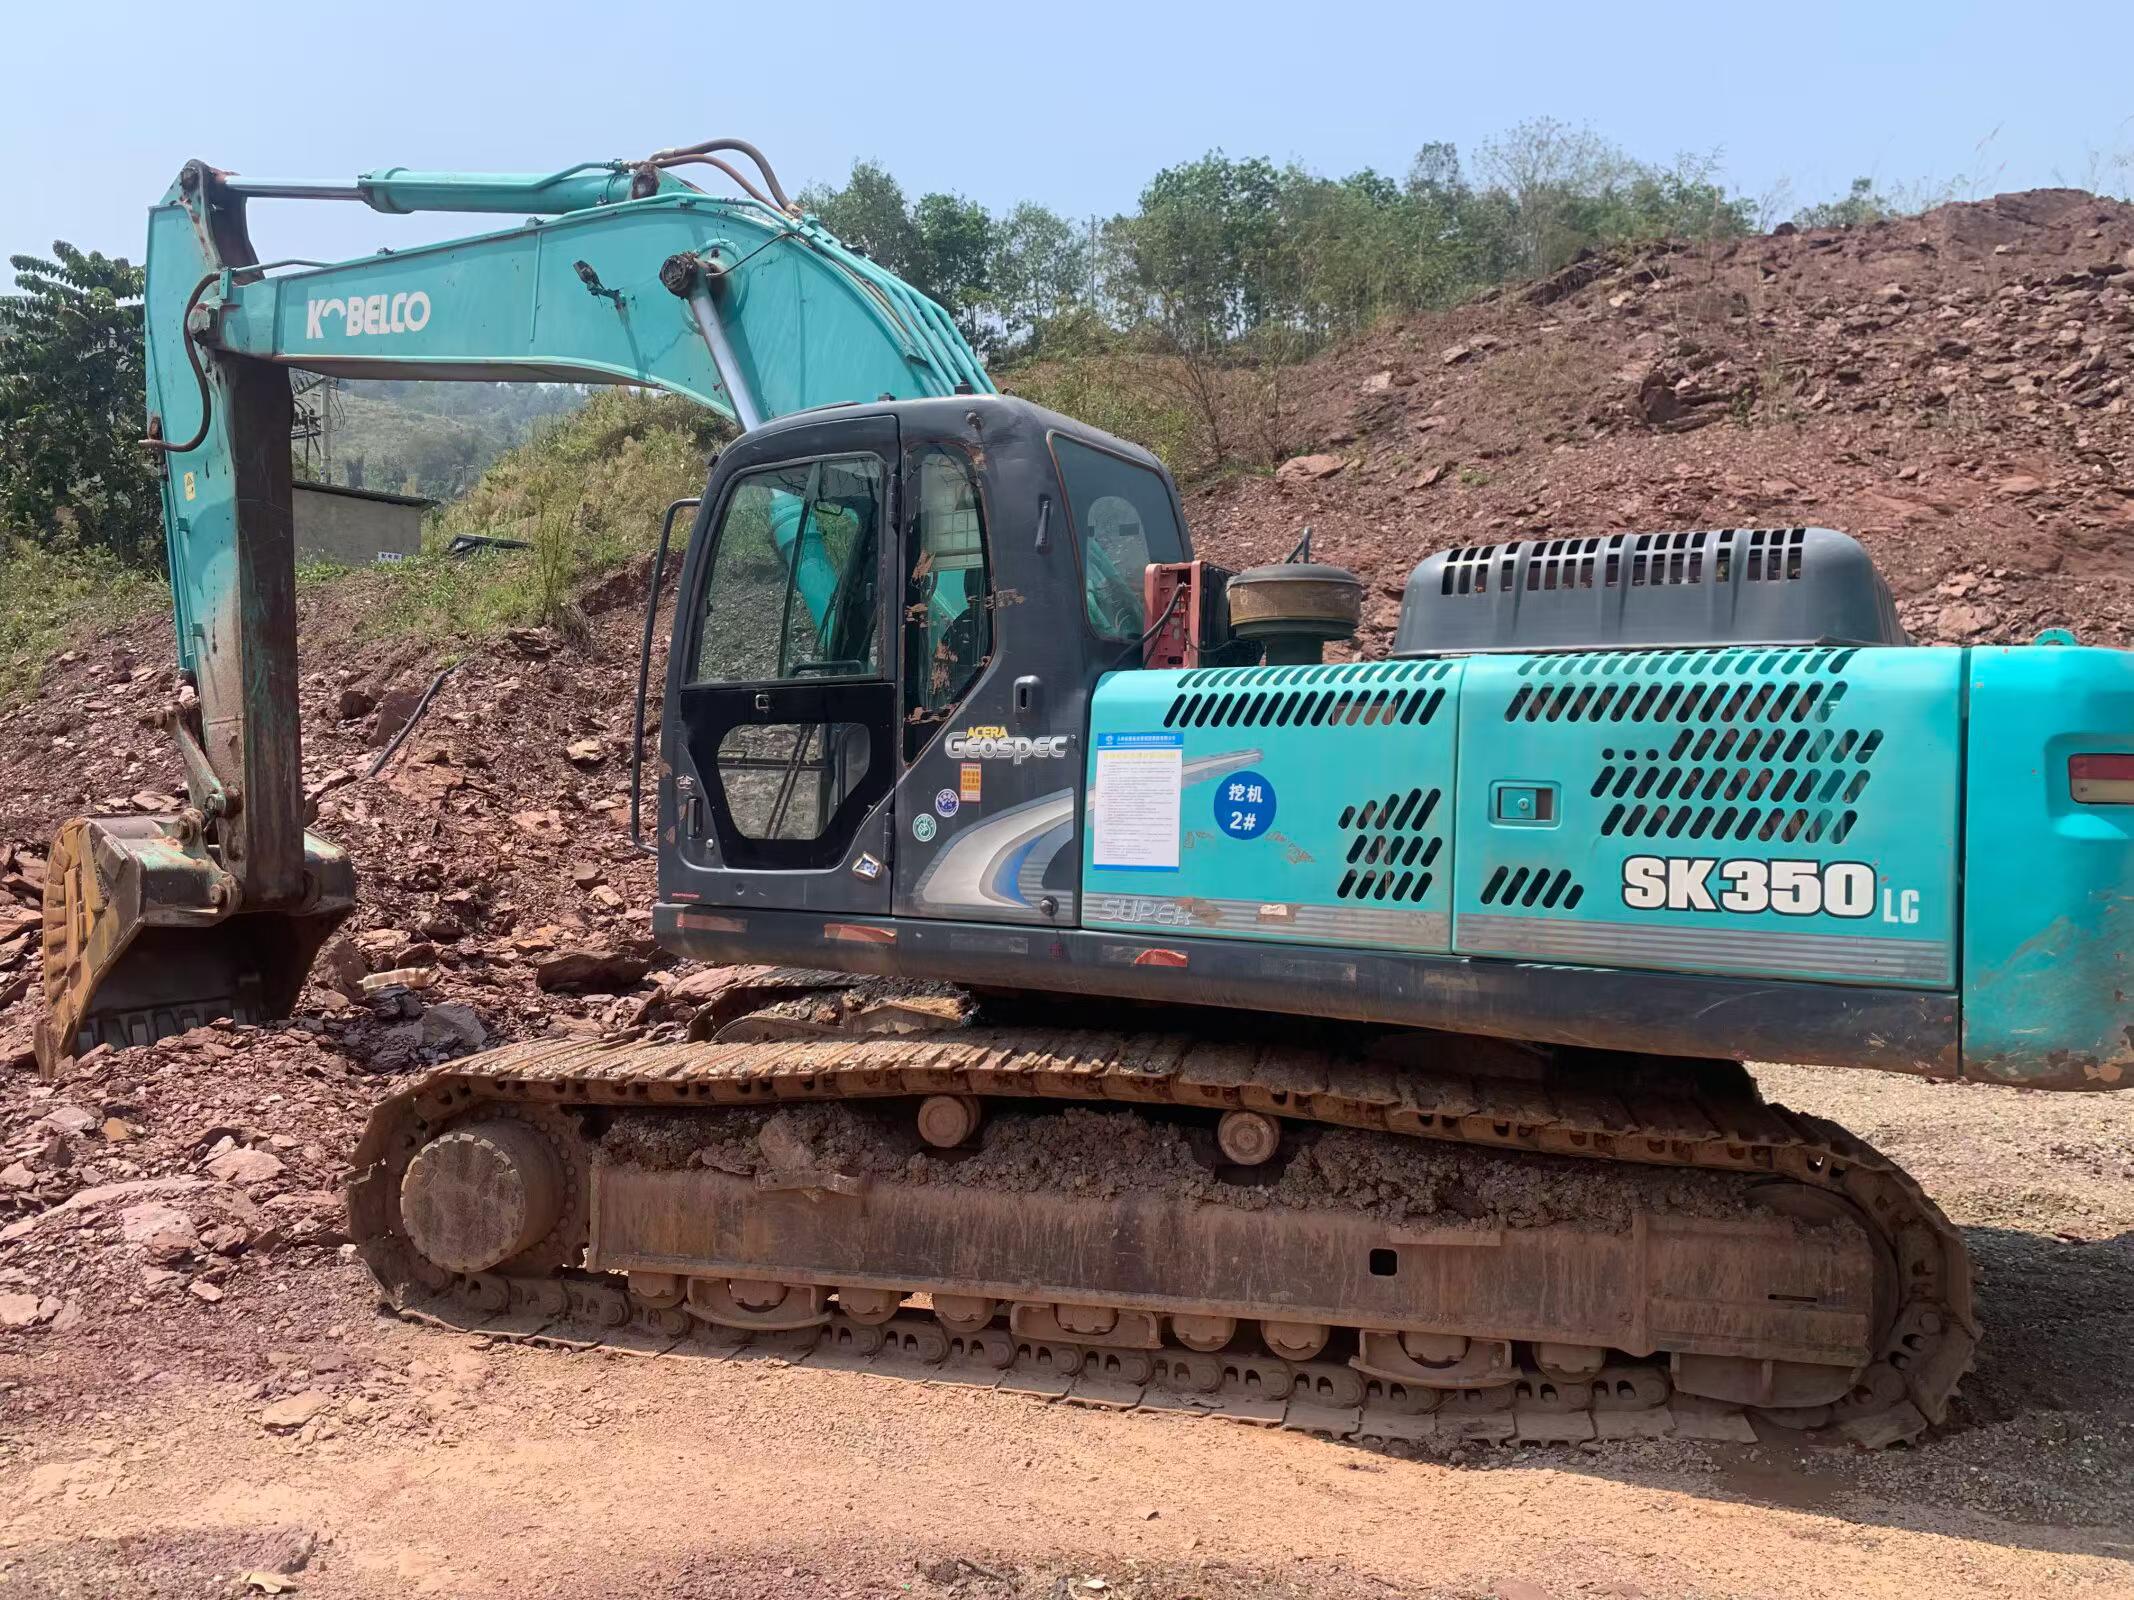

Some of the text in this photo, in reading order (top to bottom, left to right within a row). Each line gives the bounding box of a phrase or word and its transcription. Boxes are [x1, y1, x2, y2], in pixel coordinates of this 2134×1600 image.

[966, 726, 1008, 738] ACERA
[1228, 783, 1264, 803] 挖机
[1230, 811, 1257, 831] 2#
[1621, 854, 1920, 924] SK350 LC
[1098, 898, 1194, 926] SUPER
